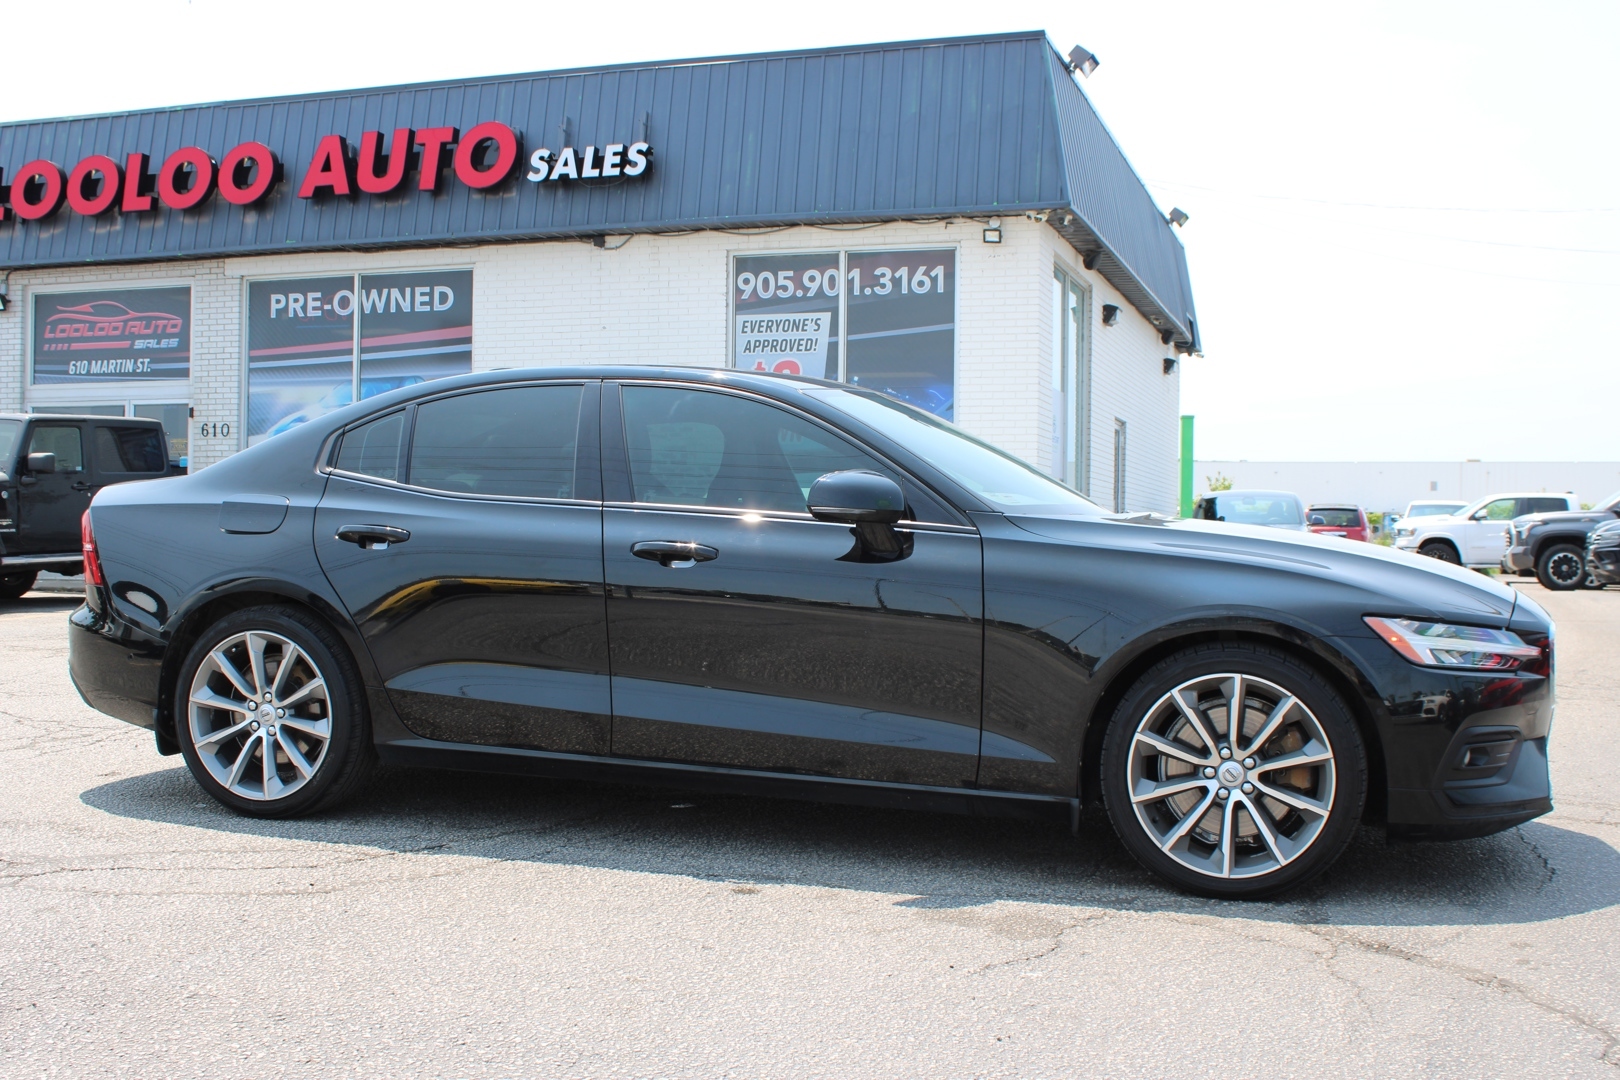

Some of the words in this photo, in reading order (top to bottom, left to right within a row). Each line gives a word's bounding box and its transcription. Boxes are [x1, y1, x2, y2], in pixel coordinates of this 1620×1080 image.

[0, 141, 275, 220] OOLOO
[297, 121, 517, 199] AUTO
[526, 141, 649, 183] SALES
[736, 264, 945, 300] 905.901.3161
[270, 286, 455, 319] PRE-OWNED
[44, 321, 124, 339] LOOLOO
[125, 319, 183, 336] AUTO
[741, 317, 822, 334] EVERYONE'S
[133, 338, 180, 350] SALES
[743, 337, 819, 354] APPROVED!
[68, 360, 88, 375] 610
[90, 358, 133, 374] MARTIN
[136, 358, 151, 373] ST.
[201, 423, 230, 437] 610
